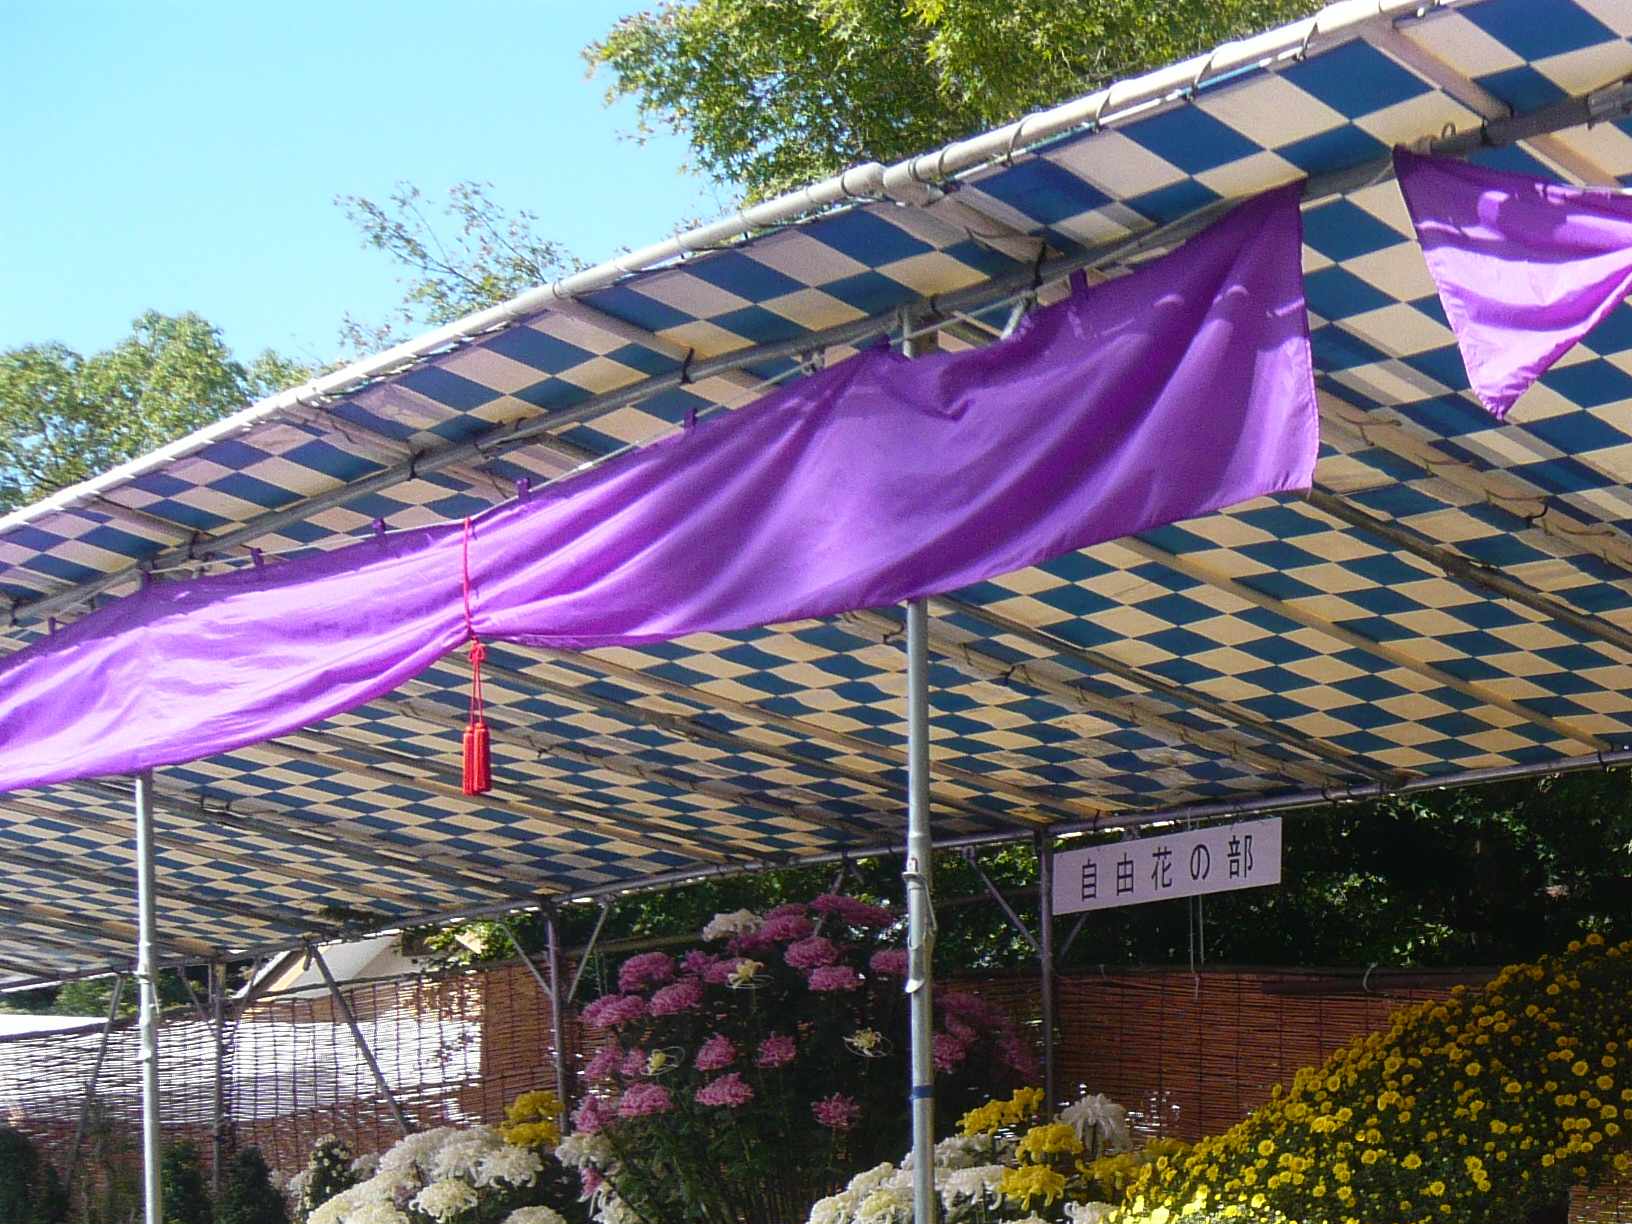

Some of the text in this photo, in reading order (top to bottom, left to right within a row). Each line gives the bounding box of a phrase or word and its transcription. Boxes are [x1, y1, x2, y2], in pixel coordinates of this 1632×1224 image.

[1081, 834, 1254, 902] 自由花の部
